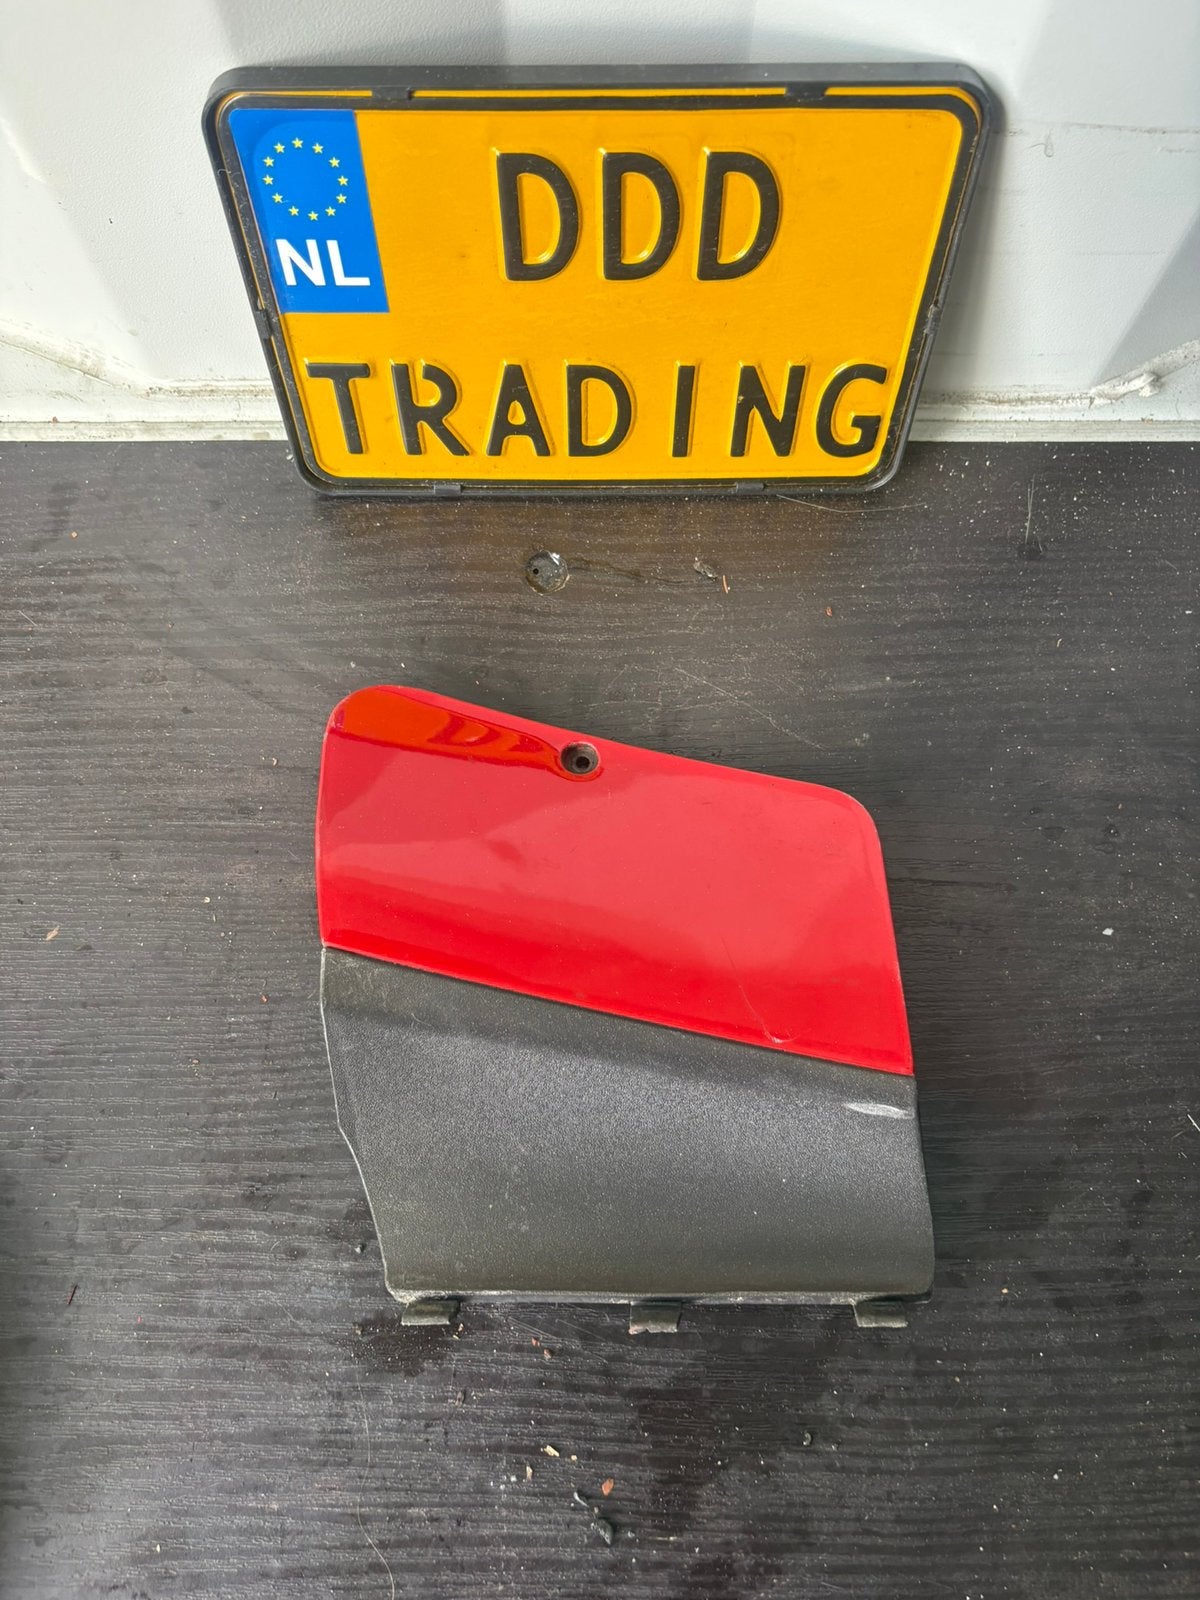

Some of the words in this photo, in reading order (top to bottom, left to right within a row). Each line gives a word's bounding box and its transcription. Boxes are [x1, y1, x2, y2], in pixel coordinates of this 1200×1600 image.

[275, 239, 371, 286] NL
[495, 152, 782, 281] DDD
[307, 363, 889, 458] TRADING
